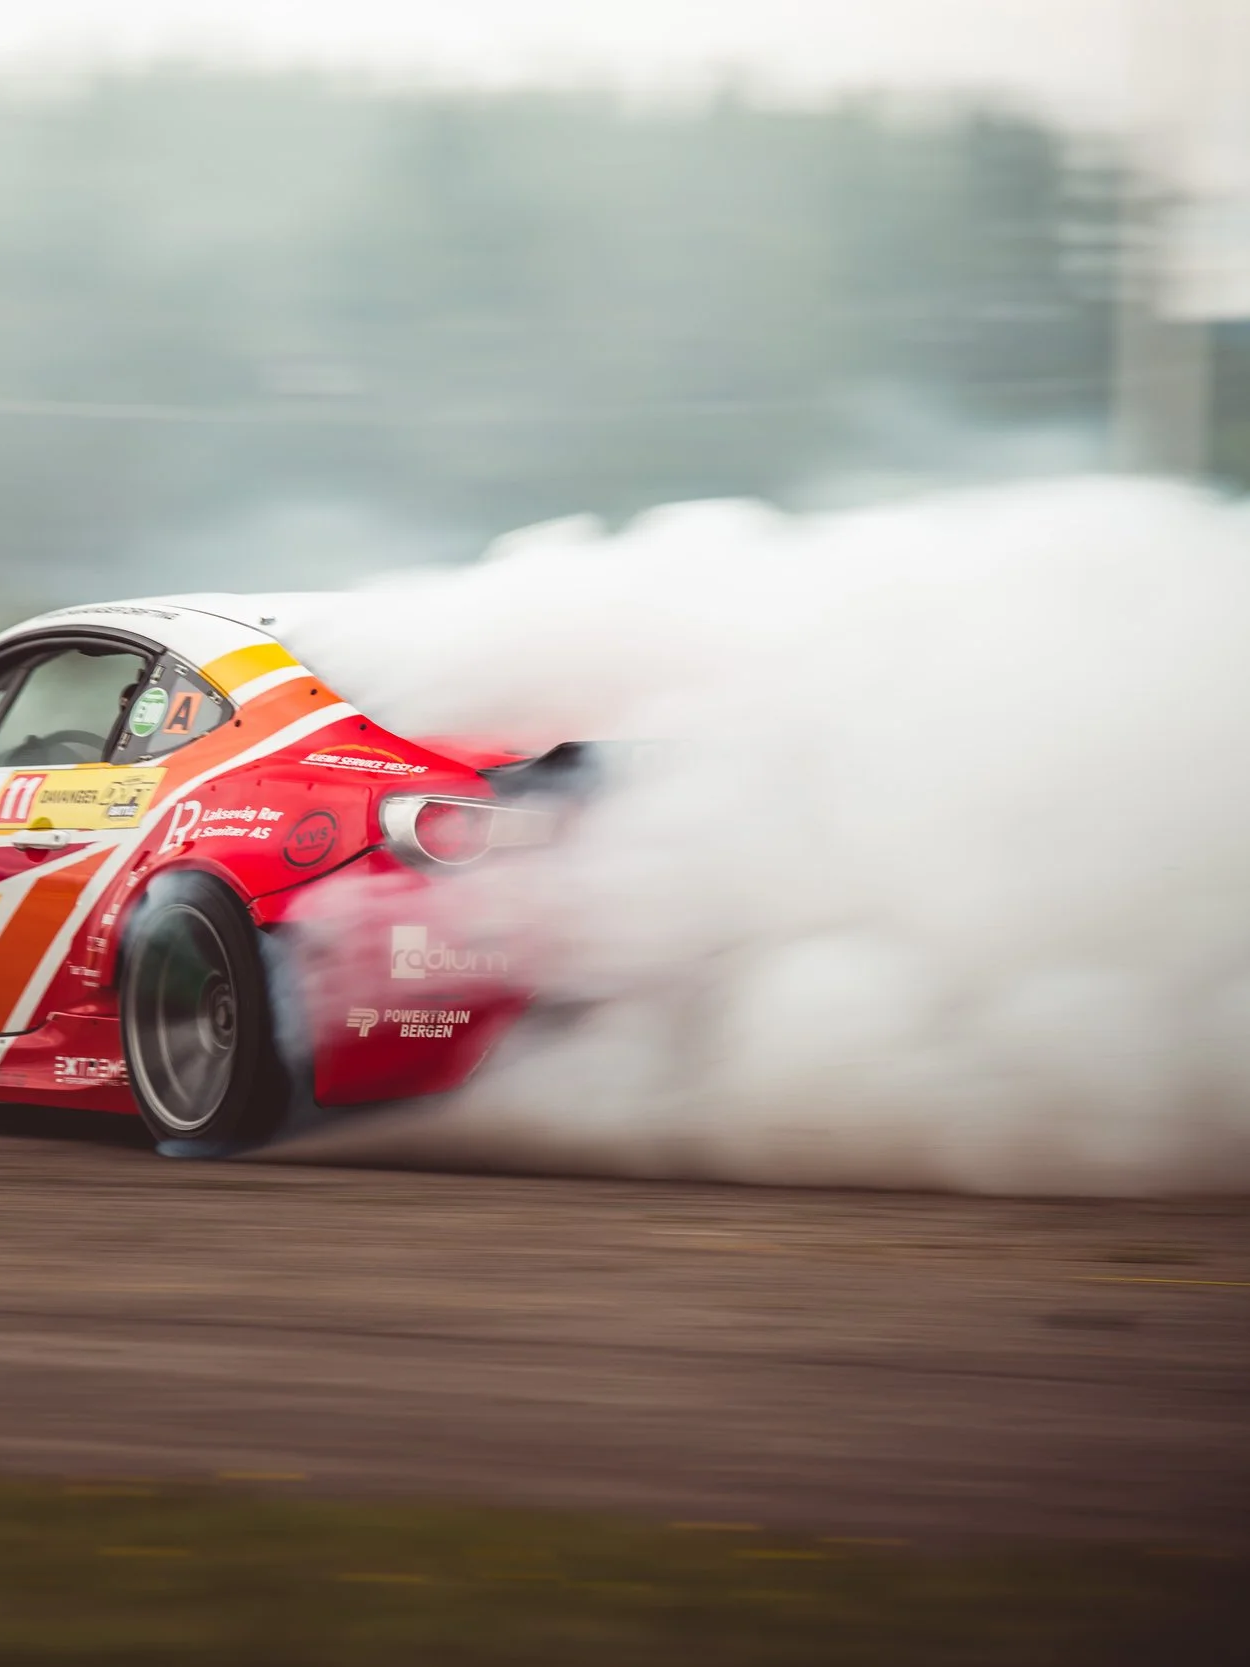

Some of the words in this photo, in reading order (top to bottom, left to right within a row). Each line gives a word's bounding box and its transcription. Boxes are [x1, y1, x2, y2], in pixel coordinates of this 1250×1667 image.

[165, 696, 192, 731] A
[0, 776, 44, 820] 11
[248, 827, 272, 839] AS
[296, 826, 329, 846] VVS
[392, 942, 508, 972] radium
[384, 1009, 470, 1024] POWERTRAIN
[400, 1024, 453, 1038] BERGEN
